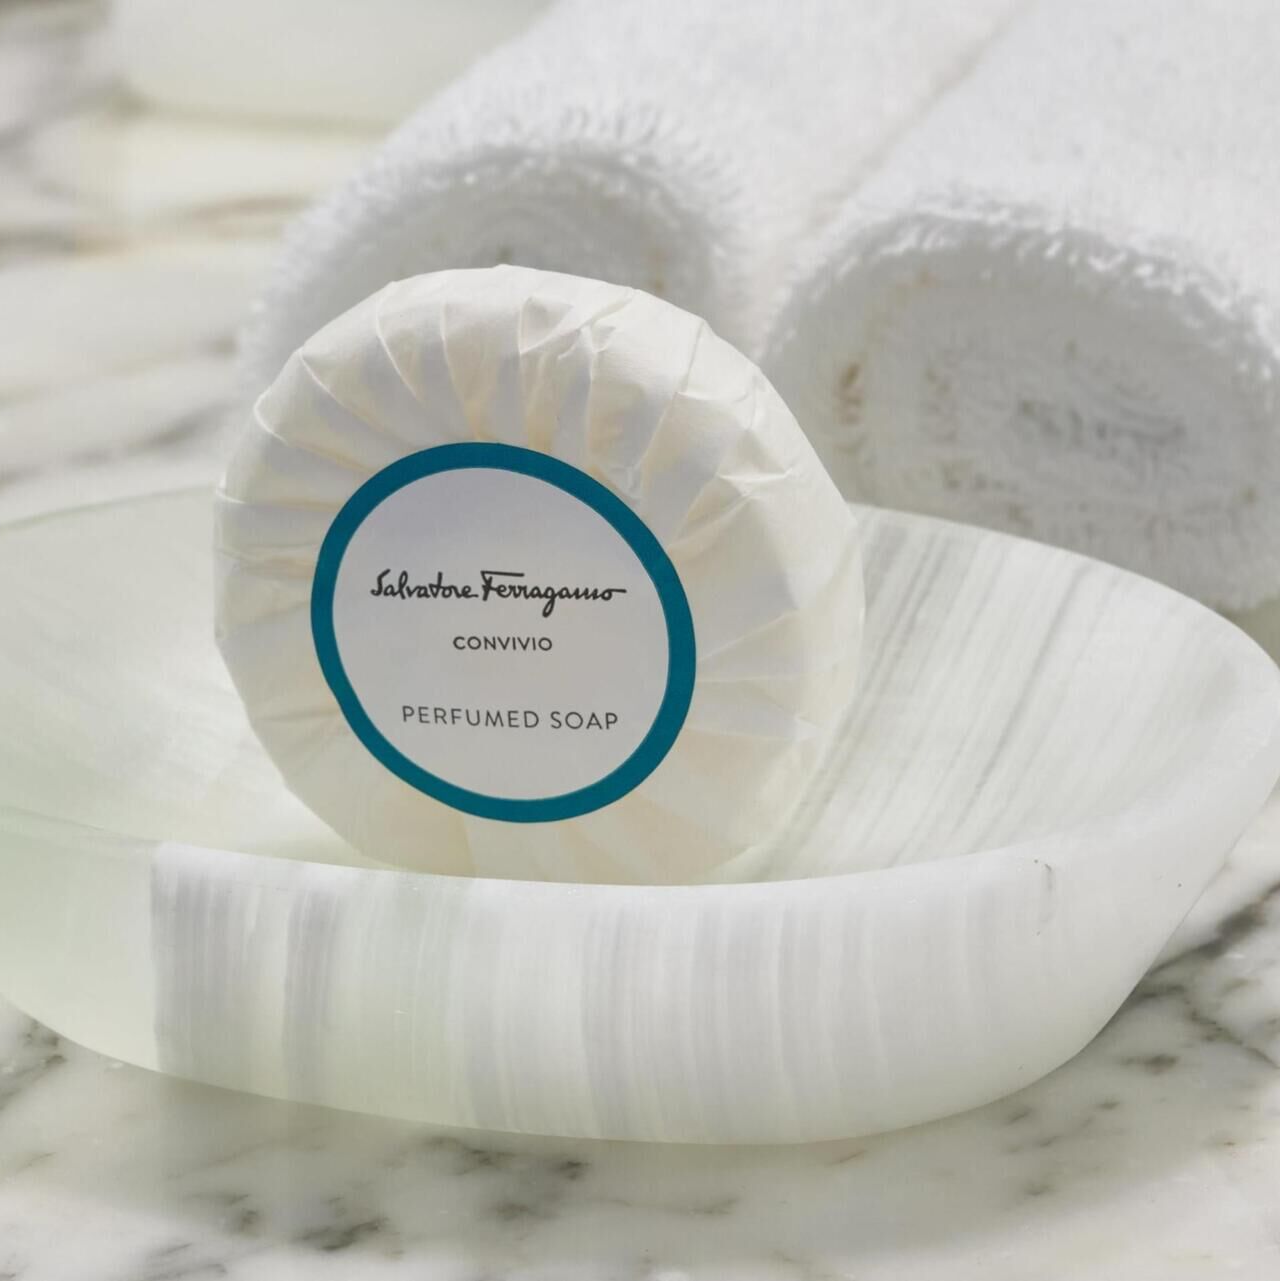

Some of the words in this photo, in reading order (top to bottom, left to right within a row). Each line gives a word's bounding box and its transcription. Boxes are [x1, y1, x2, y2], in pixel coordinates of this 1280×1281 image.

[370, 568, 478, 601] Salvatore
[480, 570, 628, 618] Ferragamo
[452, 635, 553, 652] CONVIVIO
[402, 705, 540, 729] PERFUMED
[550, 711, 619, 730] SOAP
